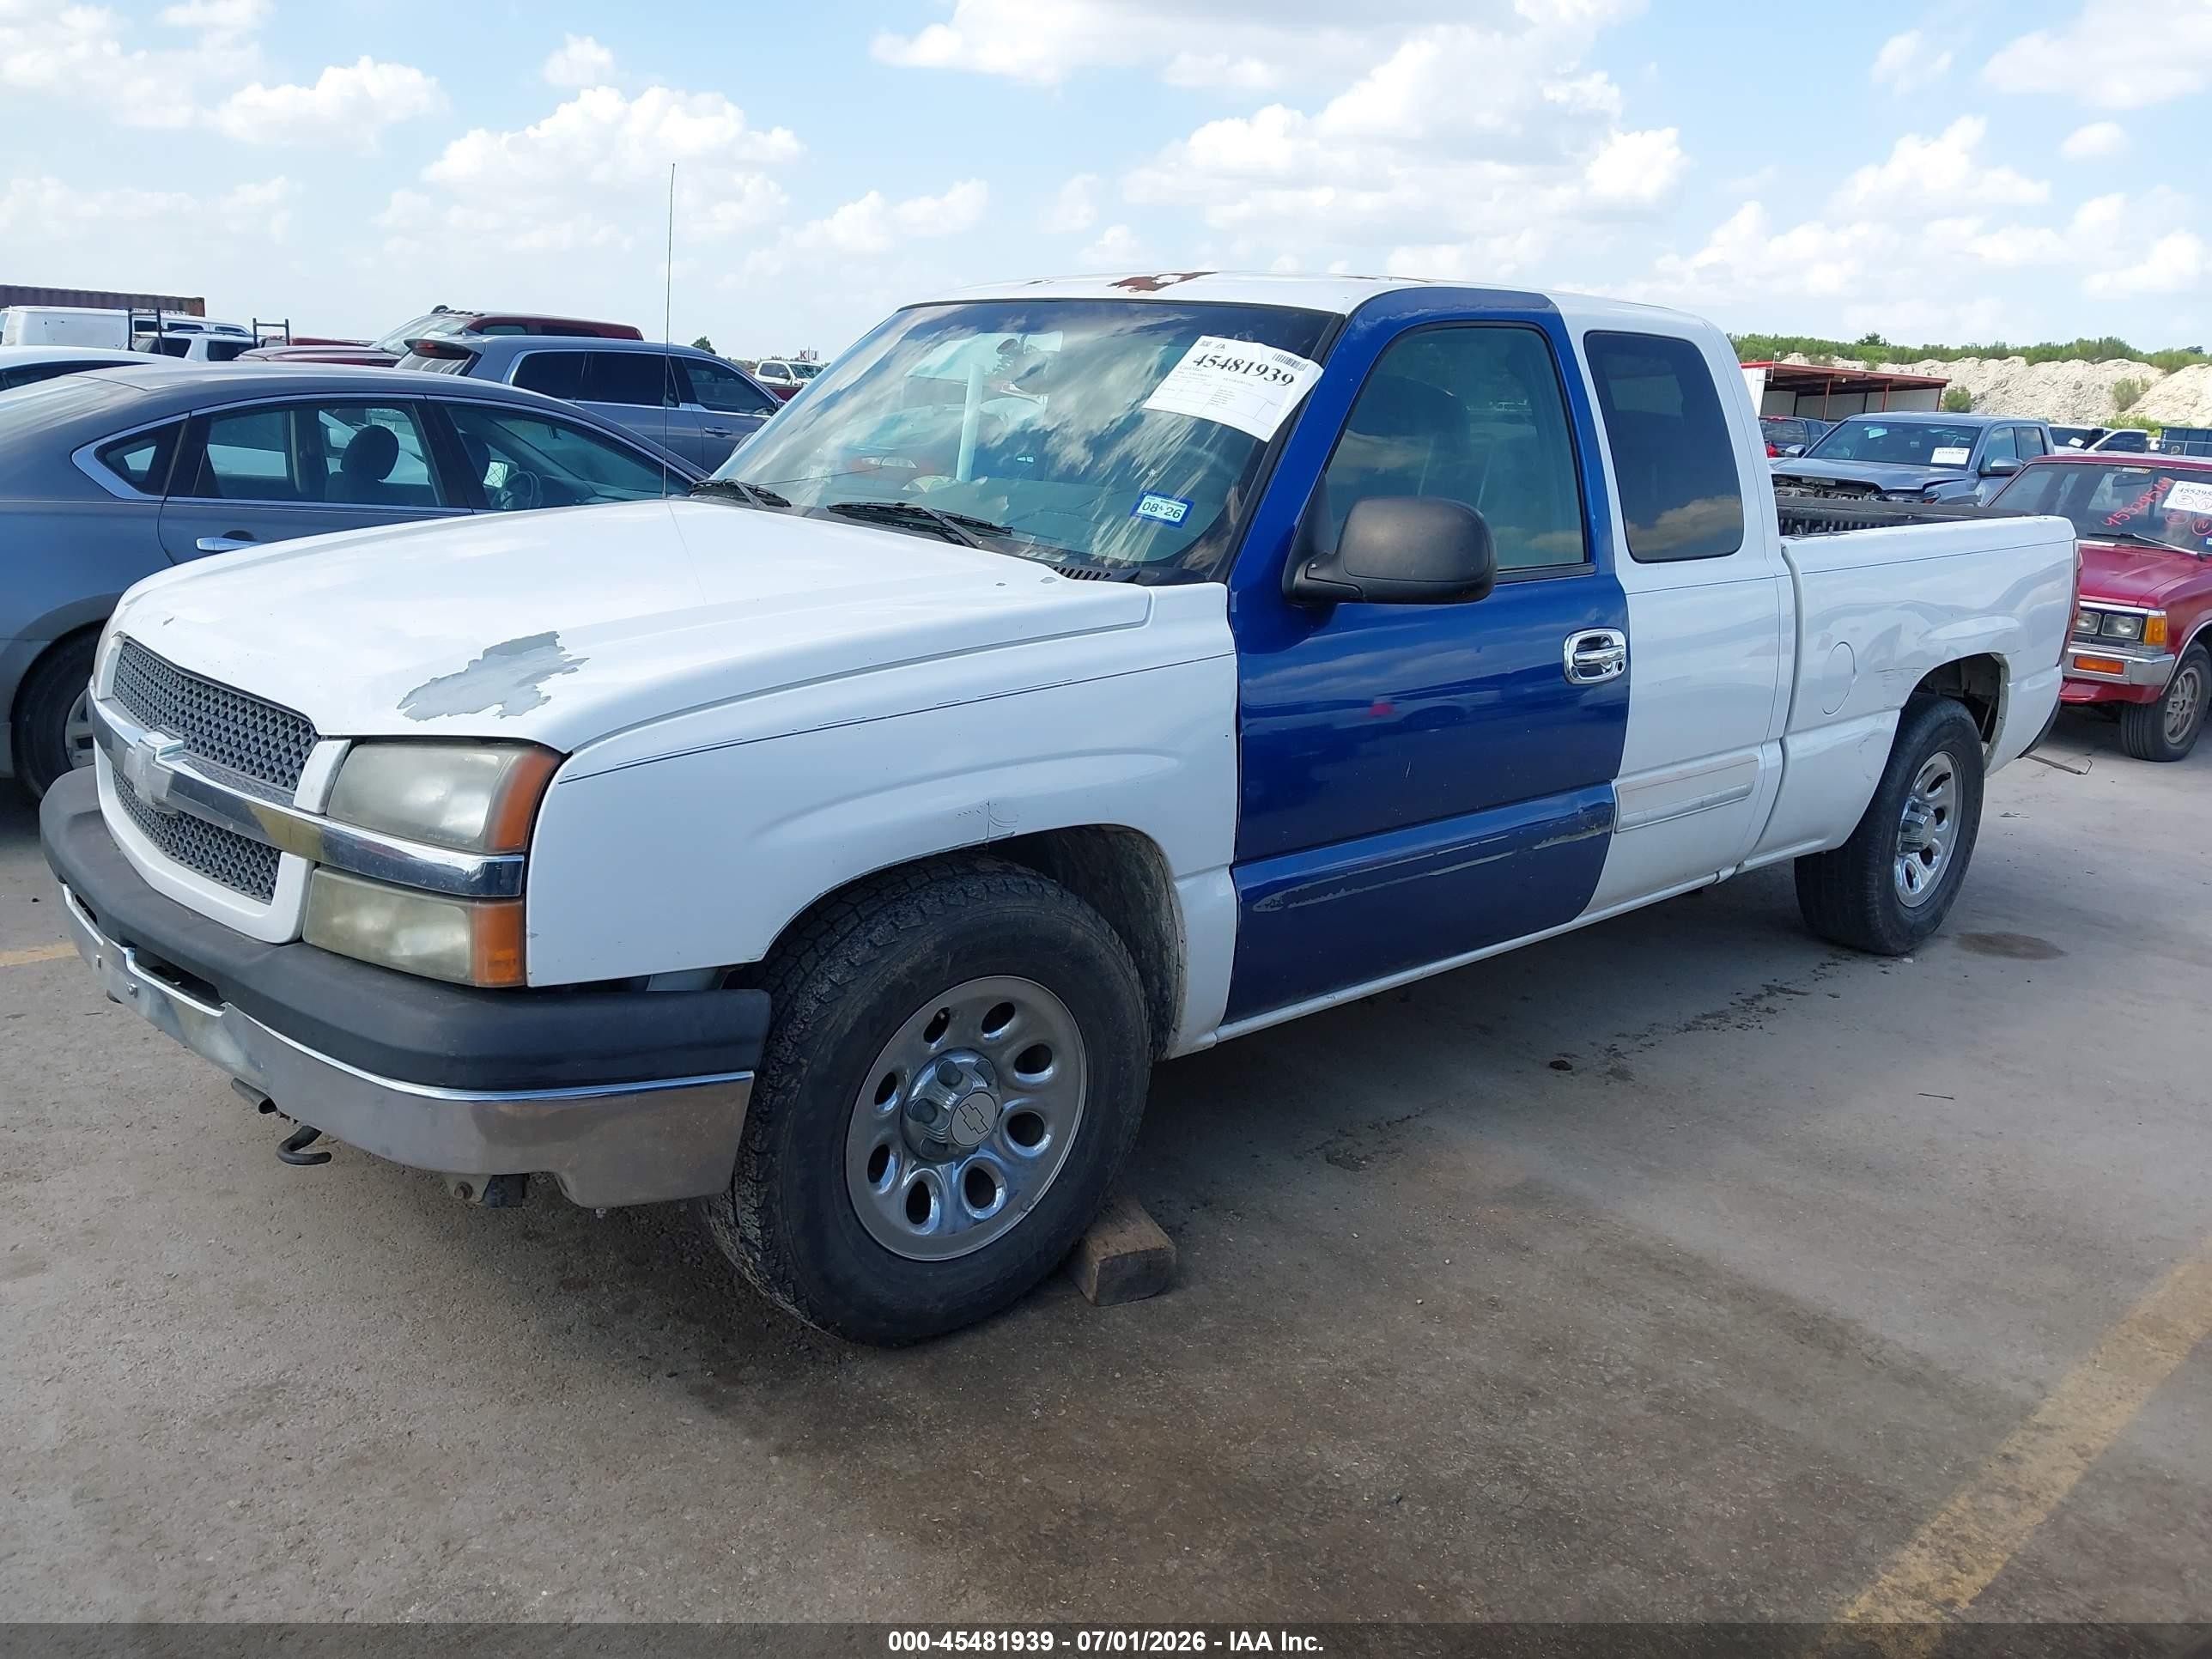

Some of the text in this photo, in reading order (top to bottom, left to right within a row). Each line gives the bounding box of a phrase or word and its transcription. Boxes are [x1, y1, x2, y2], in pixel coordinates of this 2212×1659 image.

[799, 349, 807, 360] K
[812, 350, 818, 361] J
[1193, 353, 1295, 386] 45481939
[1141, 501, 1159, 513] 08
[1164, 507, 1182, 519] 26
